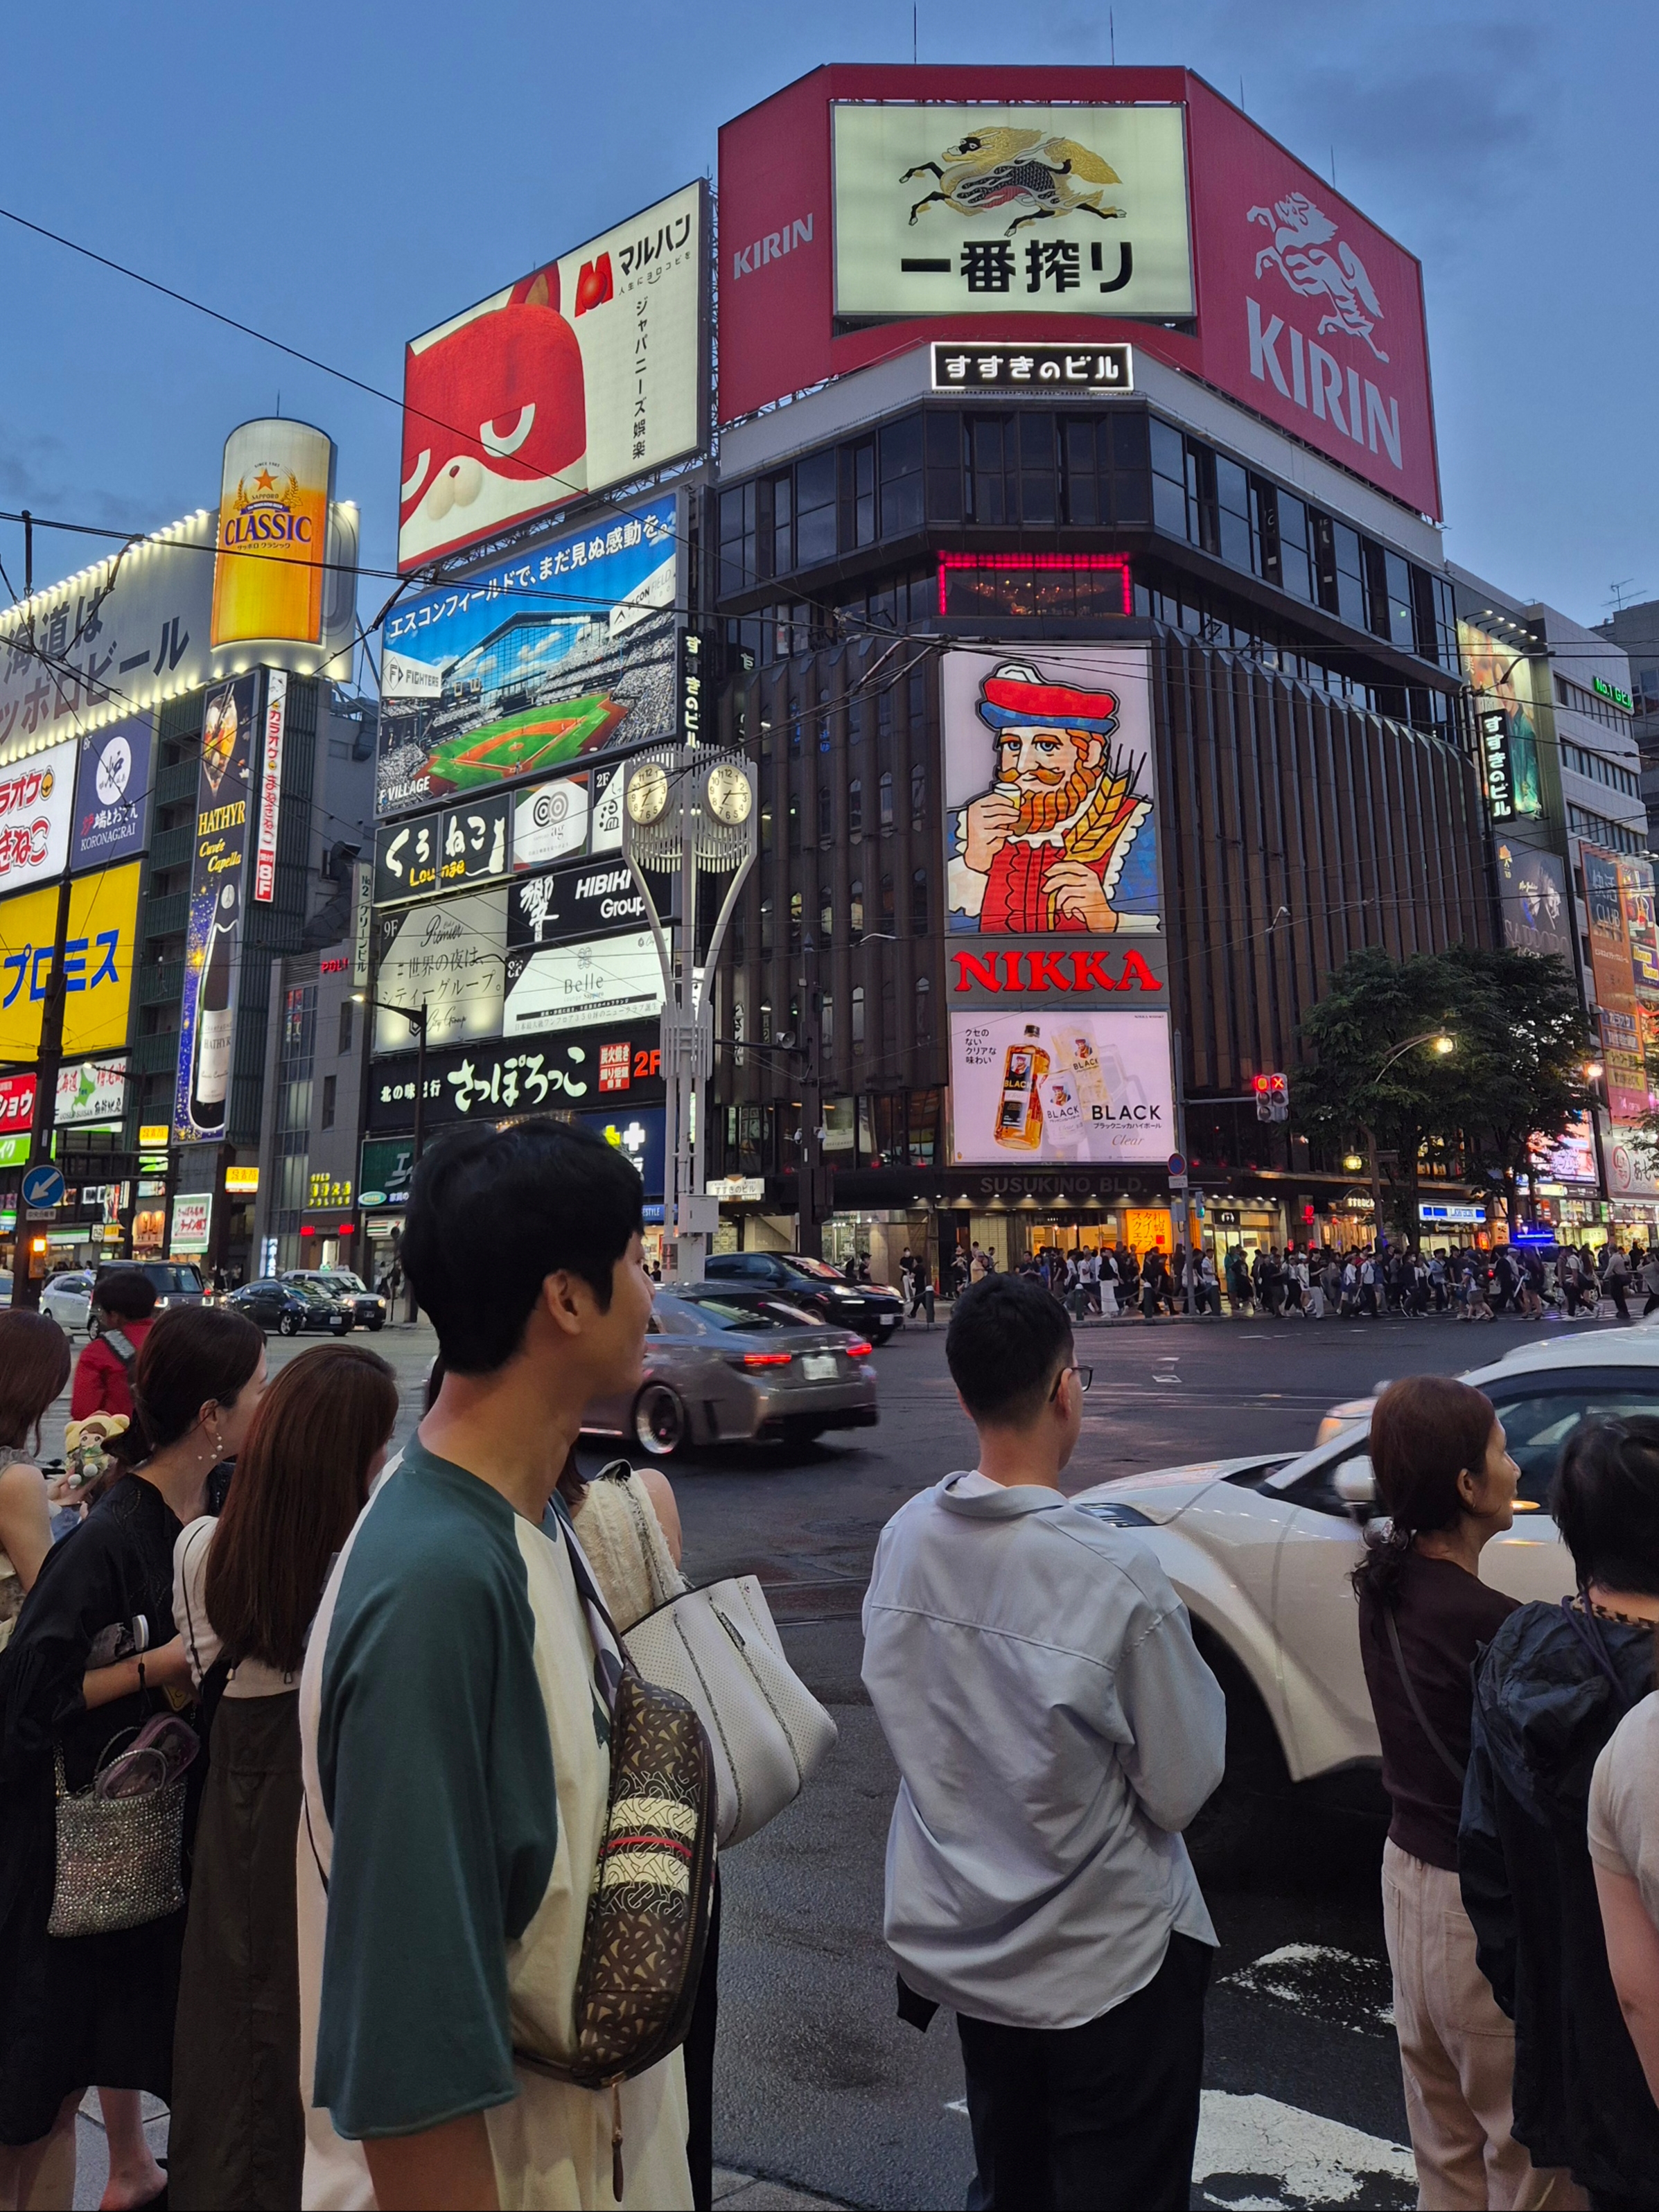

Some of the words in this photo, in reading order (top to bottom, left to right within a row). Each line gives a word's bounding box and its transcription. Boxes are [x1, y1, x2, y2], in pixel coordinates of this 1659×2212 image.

[619, 214, 690, 276] マルハン
[733, 213, 814, 280] KIRIN
[619, 252, 690, 296] 人生にヨロコビを
[901, 239, 1133, 293] 一番搾り
[632, 296, 648, 460] ジャパニーズ娯楽
[945, 355, 1119, 380] すすきのビル
[1246, 296, 1403, 471] KIRIN
[225, 514, 312, 546] CLASSIC
[389, 514, 668, 639] エスコンフィールドで、まだ見ぬ感動を。
[405, 669, 439, 687] FIGHTERS
[725, 769, 732, 778] 12
[1484, 715, 1511, 817] すすきのビル
[387, 776, 430, 802] VILLAGE
[596, 772, 611, 788] 2F
[712, 778, 719, 786] 10
[198, 800, 245, 836] HATHYR
[199, 838, 225, 858] Cuvée
[386, 815, 486, 877] くろねこ
[207, 851, 241, 873] Capella
[410, 860, 465, 887] Lounge
[258, 864, 273, 896] 8F
[575, 869, 632, 899] HIBIKI
[600, 897, 646, 919] Group
[1597, 904, 1620, 927] CLUB
[384, 920, 398, 939] 9F
[3, 929, 119, 1009] プロミス
[951, 949, 1164, 994] NIKKA
[383, 969, 501, 1006] シティーグループ。
[565, 973, 604, 994] Belle
[965, 1028, 990, 1037] クセの
[634, 1049, 661, 1078] 2F
[965, 1047, 997, 1055] クリアな
[966, 1056, 992, 1064] 味わい
[1073, 1058, 1098, 1070] BLACK
[447, 1046, 587, 1112] さっぽろっこ
[1004, 1080, 1033, 1089] BLACK
[1047, 1105, 1079, 1118] BLACK
[1092, 1105, 1161, 1120] BLACK
[1112, 1134, 1145, 1146] Clear
[715, 1185, 756, 1194] すすきのビル
[980, 1177, 1089, 1193] SUSUKINO
[1100, 1177, 1147, 1193] BLD.
[1132, 1212, 1142, 1247] スクエア
